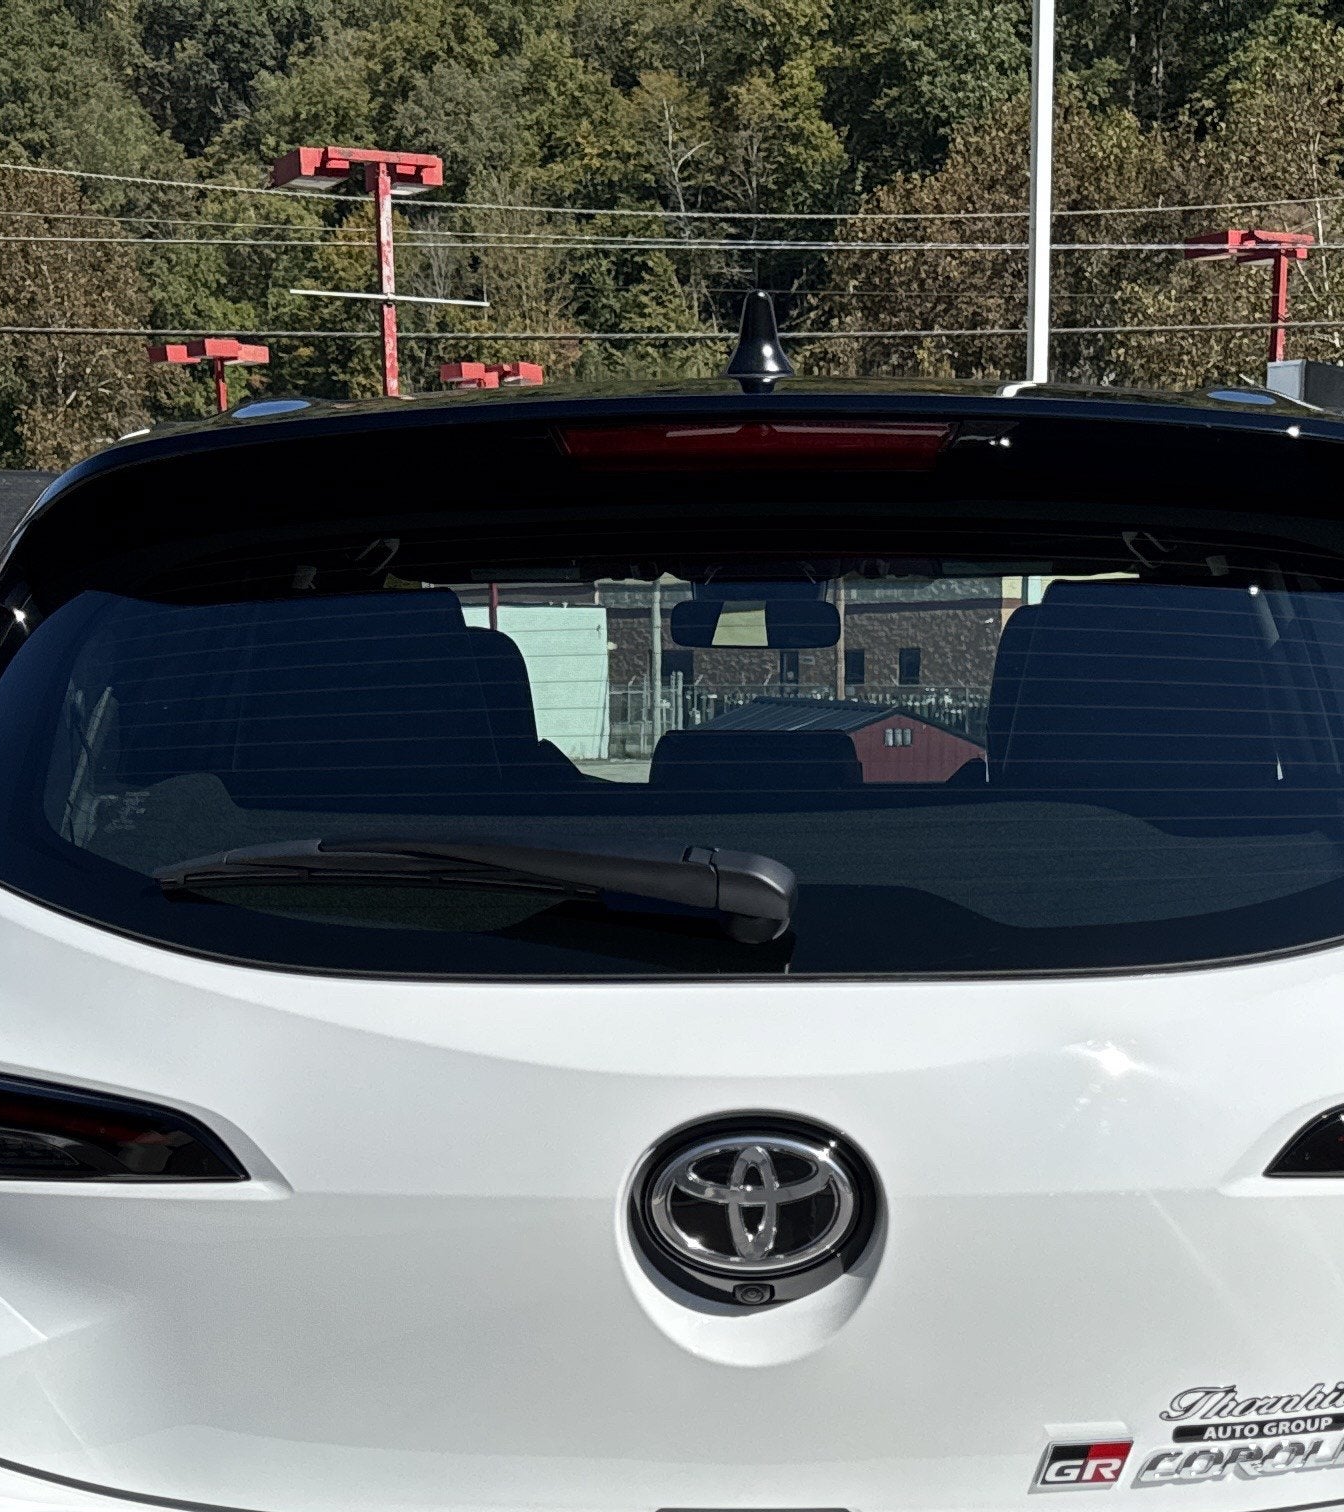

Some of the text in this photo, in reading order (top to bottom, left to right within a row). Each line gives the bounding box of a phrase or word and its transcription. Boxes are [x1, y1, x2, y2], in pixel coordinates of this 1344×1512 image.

[1203, 1416, 1334, 1441] AUTO GROUP
[1044, 1457, 1124, 1484] GR
